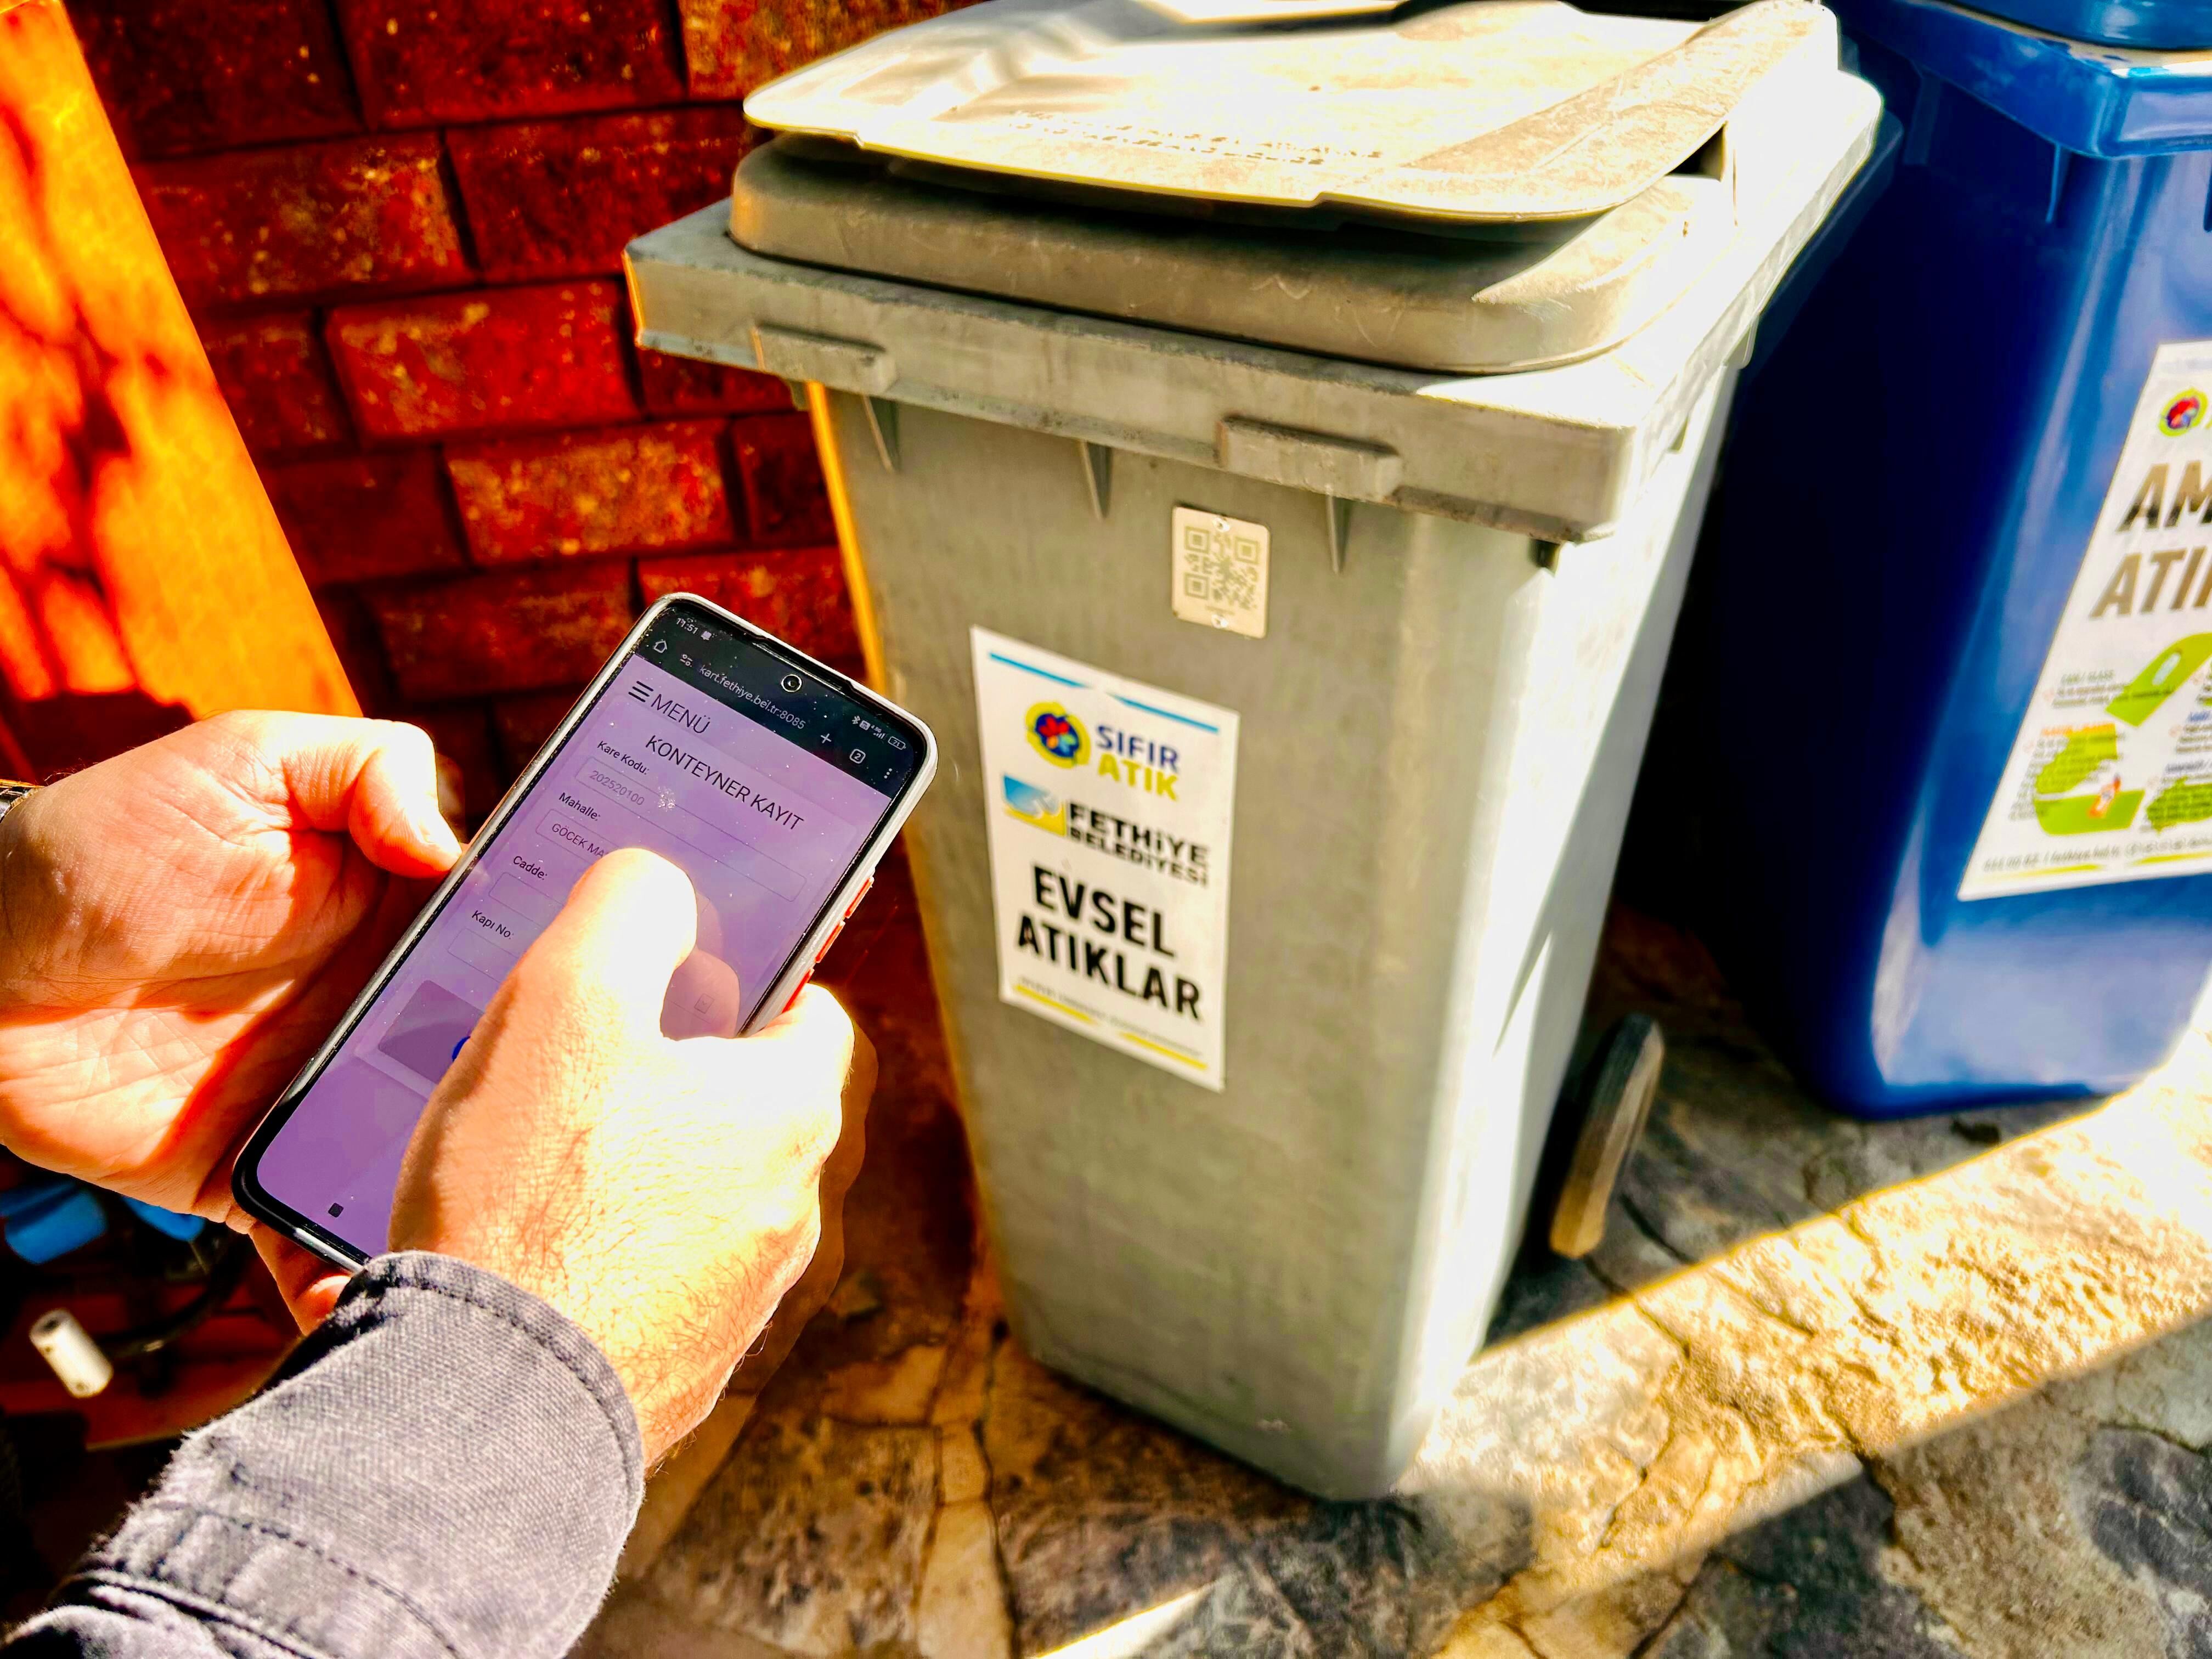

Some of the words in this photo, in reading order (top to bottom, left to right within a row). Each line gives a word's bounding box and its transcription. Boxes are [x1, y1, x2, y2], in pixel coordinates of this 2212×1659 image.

[676, 618, 698, 634] 11:51
[651, 693, 711, 734] MENÜ
[597, 741, 620, 758] Kare
[620, 754, 650, 775] Kodu:
[1097, 725, 1178, 772] SIFIR
[589, 770, 645, 806] 202520100
[645, 735, 751, 803] KONTEYNER
[751, 794, 804, 830] KAYIT
[1098, 753, 1177, 802] ATIK
[558, 792, 601, 821] Mahalle:
[552, 823, 589, 849] GÖCEK
[514, 856, 548, 881] Cadde:
[471, 910, 495, 929] Kapı
[495, 923, 515, 940] No:
[1034, 865, 1176, 958] EVSEL
[1018, 915, 1200, 1019] ATIKLAR
